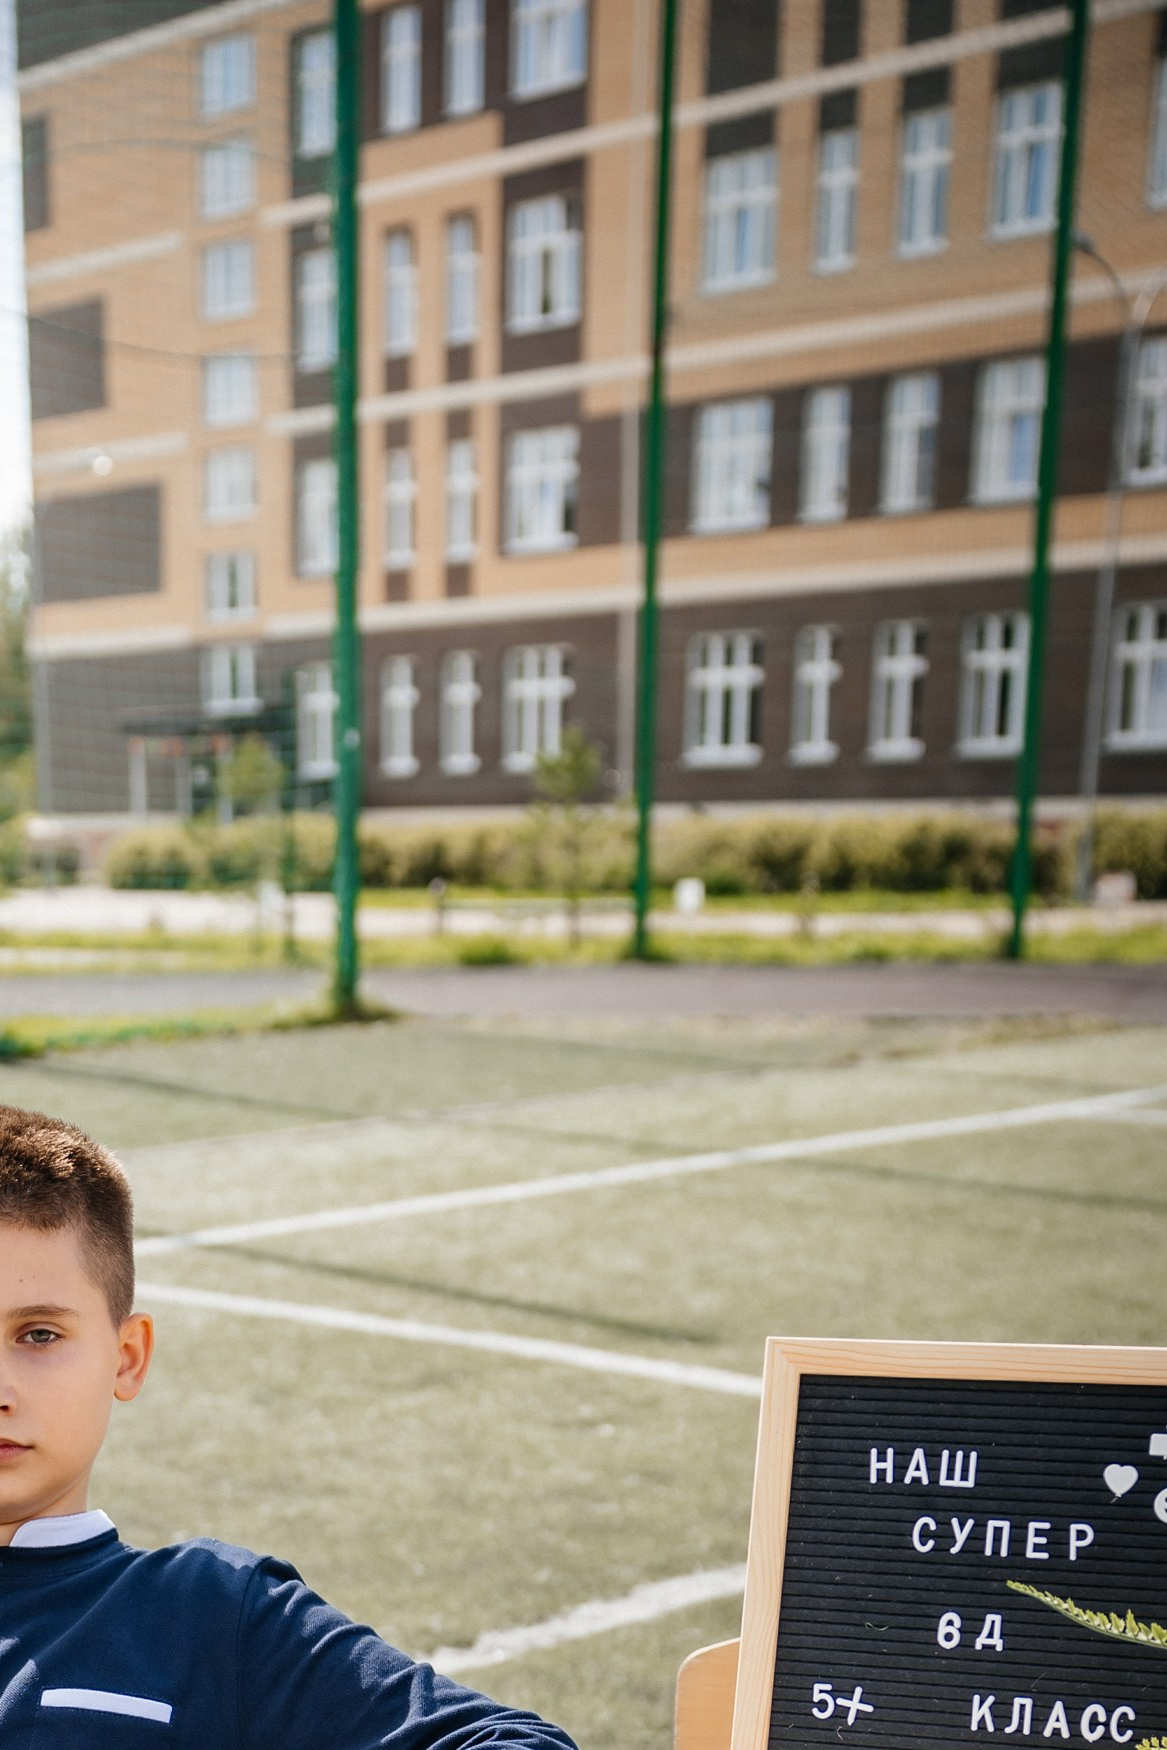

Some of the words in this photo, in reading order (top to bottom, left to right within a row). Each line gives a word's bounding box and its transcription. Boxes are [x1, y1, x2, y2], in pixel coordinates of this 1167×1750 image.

[869, 1447, 978, 1488] НАШ
[912, 1516, 1095, 1561] СУПЕР
[811, 1682, 875, 1727] 5+
[970, 1694, 1136, 1743] КЛАСС
